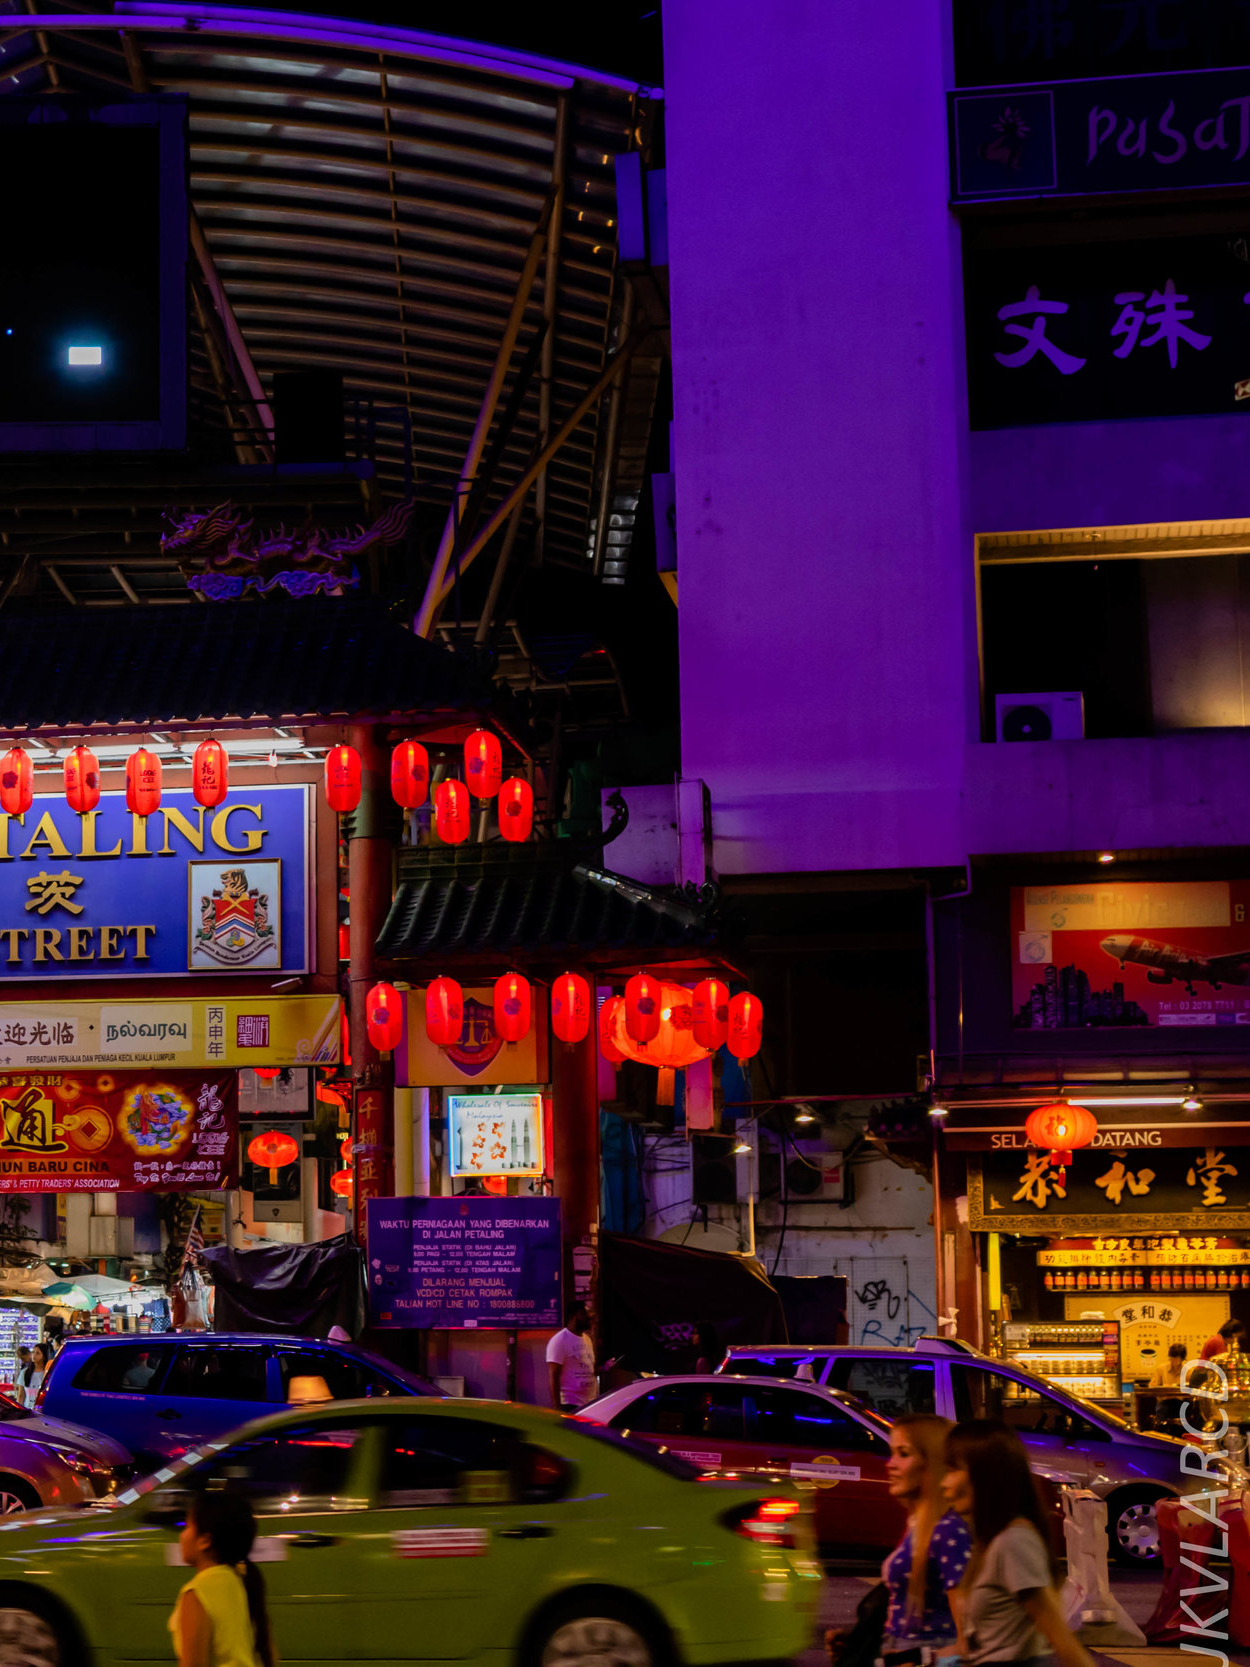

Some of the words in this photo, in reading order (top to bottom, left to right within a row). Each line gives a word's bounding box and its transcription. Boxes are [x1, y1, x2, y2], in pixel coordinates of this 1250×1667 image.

[208, 1007, 224, 1058] 丙申年
[26, 1056, 57, 1064] PERSATUAN
[58, 1055, 81, 1063] PENJAJA
[95, 1054, 117, 1062] PENIAGA
[153, 1053, 175, 1061] LUMPUR
[1090, 1131, 1162, 1147] DATANG
[28, 1161, 67, 1172] BARU
[76, 1161, 110, 1172] CINA
[19, 1179, 40, 1188] PETTY
[74, 1178, 120, 1188] ASSOCIATION
[380, 1220, 409, 1228] WAKTU
[412, 1220, 465, 1228] PERNIAGAAN
[470, 1220, 492, 1228] YANG
[495, 1220, 549, 1228] DIBENARKAN
[423, 1230, 432, 1238] DI
[434, 1230, 462, 1238] JALAN
[465, 1230, 504, 1238] PETALING
[422, 1278, 465, 1286] DILARANG
[469, 1278, 506, 1286] MENJUAL
[449, 1289, 476, 1297] CETAK
[479, 1288, 512, 1297] ROMPAK
[395, 1300, 423, 1308] TALIAN
[425, 1300, 442, 1308] HOT
[446, 1300, 464, 1308] LINE
[468, 1300, 480, 1308] NO
